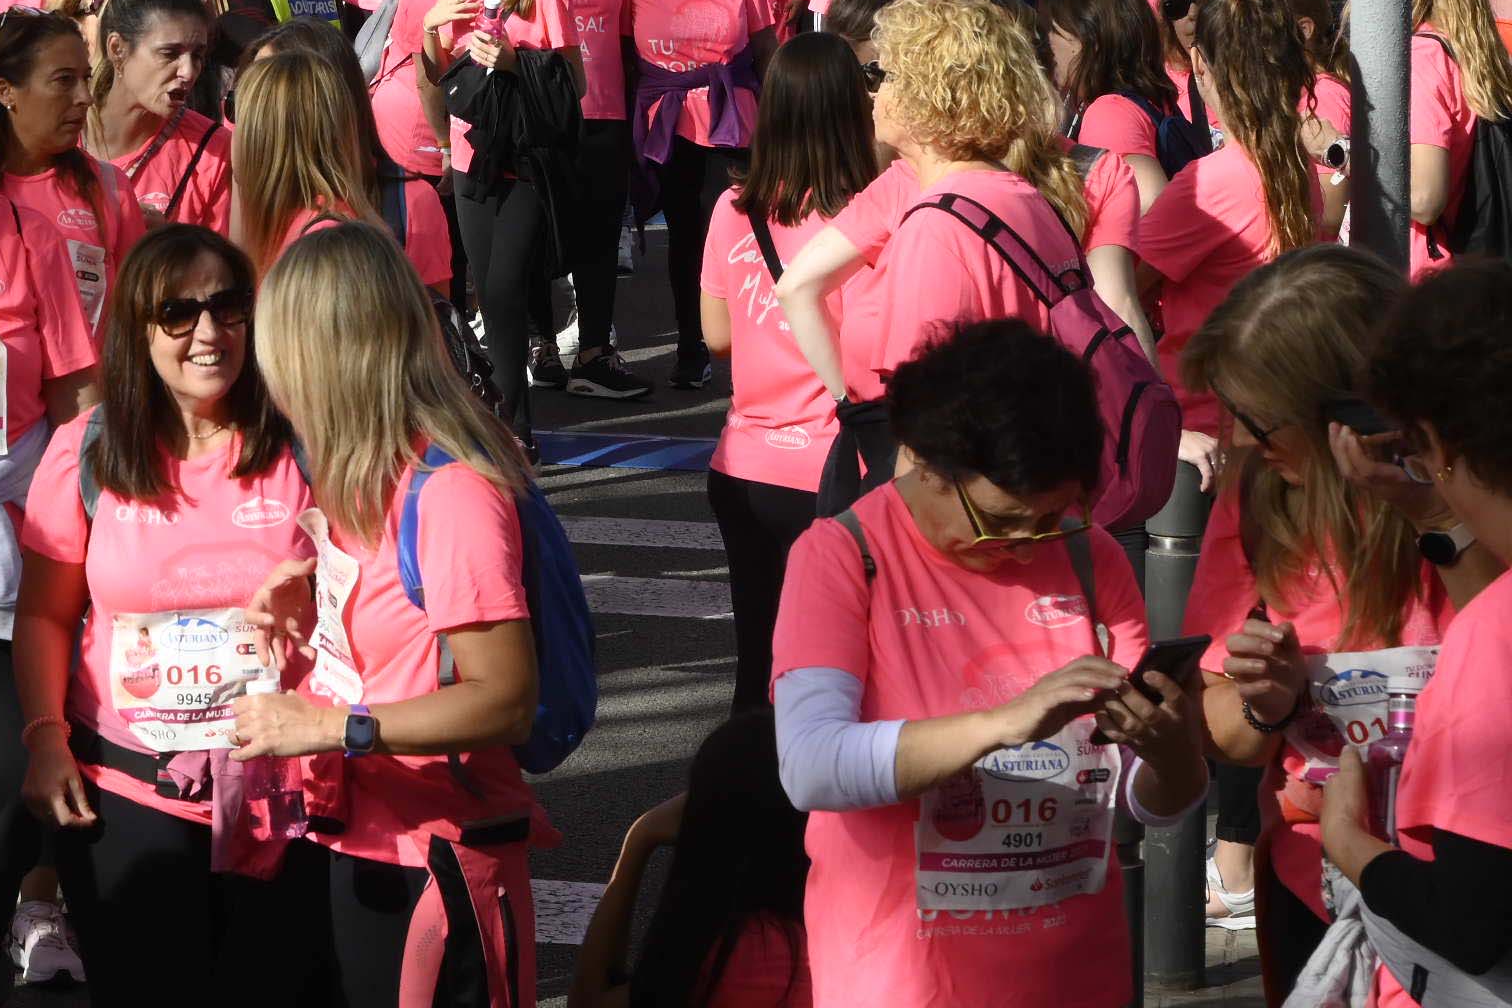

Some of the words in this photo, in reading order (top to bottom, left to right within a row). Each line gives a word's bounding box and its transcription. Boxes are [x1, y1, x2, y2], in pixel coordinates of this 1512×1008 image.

[576, 15, 606, 34] SAL
[649, 38, 675, 54] TU
[234, 622, 258, 634] SUM
[166, 663, 224, 687] 016
[176, 691, 213, 706] 9945
[175, 710, 191, 722] DE
[204, 706, 236, 722] MUJE
[1346, 716, 1389, 747] 01
[990, 753, 1065, 773] ASTURIANA
[991, 797, 1058, 824] 016
[1001, 831, 1044, 849] 4901
[941, 857, 997, 870] CARRERA
[1000, 857, 1016, 868] DE
[934, 881, 998, 898] OYSHO
